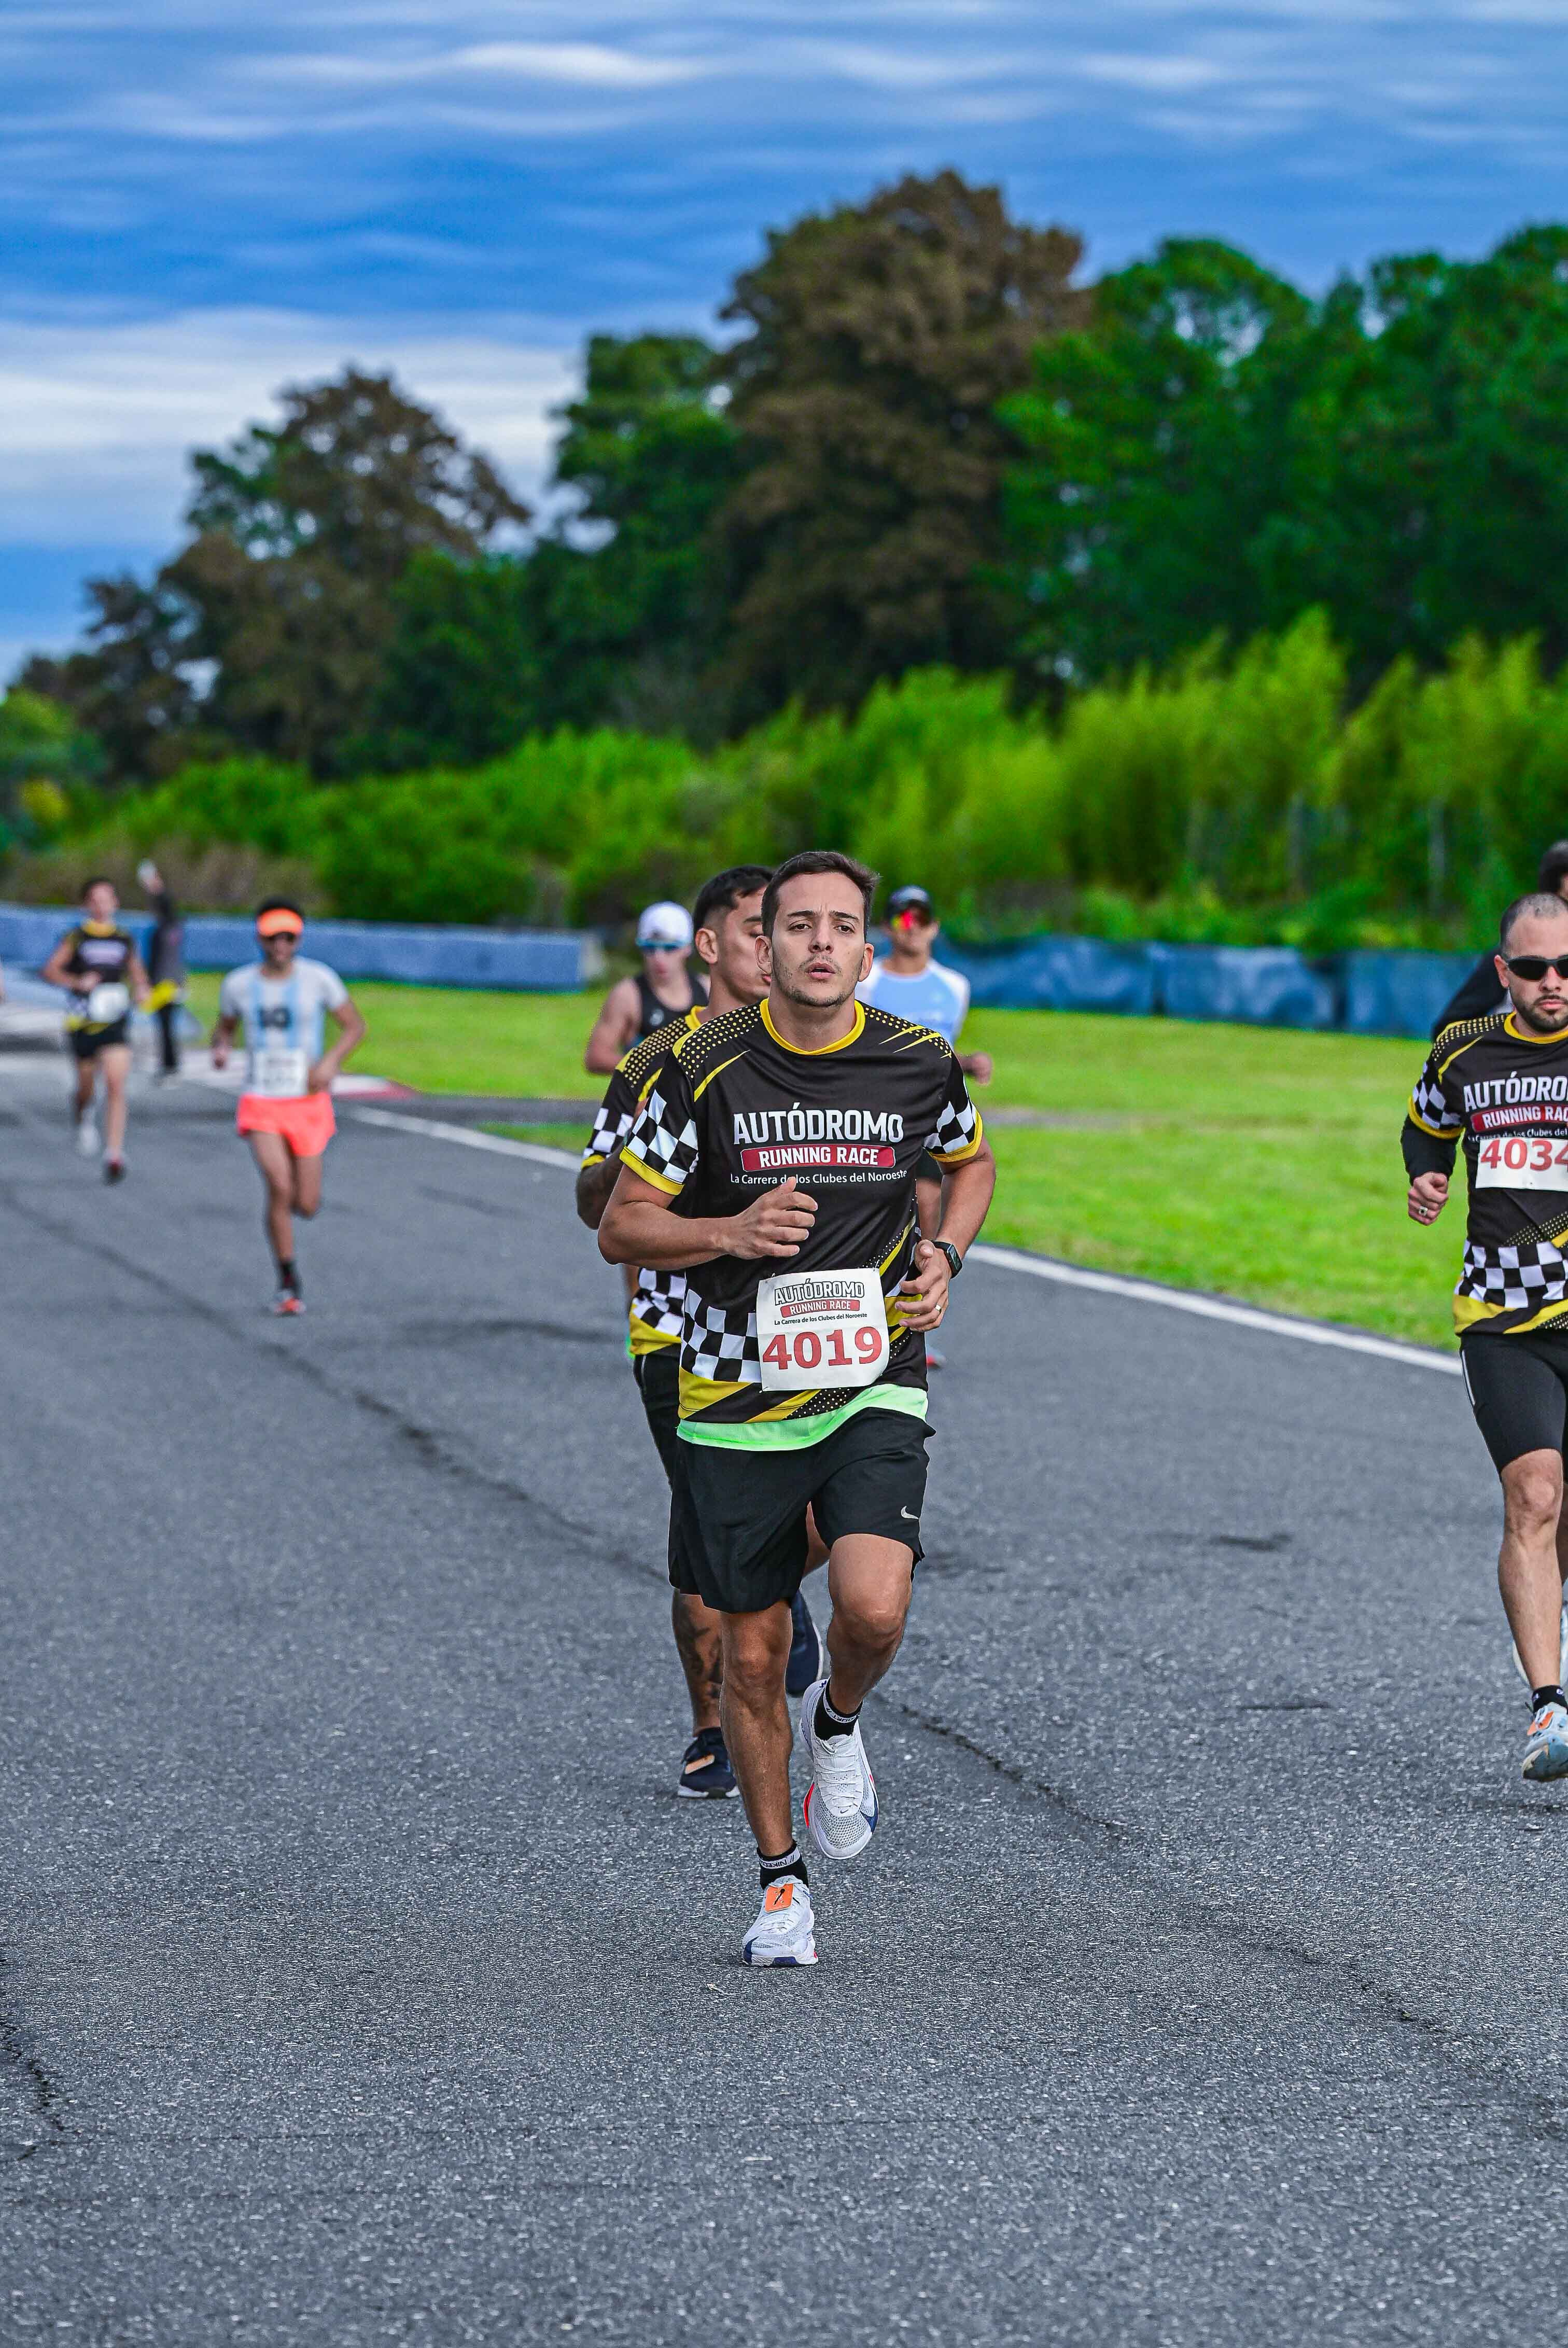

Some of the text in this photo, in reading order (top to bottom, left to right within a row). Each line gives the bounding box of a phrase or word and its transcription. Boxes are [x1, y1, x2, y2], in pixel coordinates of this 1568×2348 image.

[1463, 1071, 1568, 1112] AUTÓDRO
[733, 1102, 904, 1144] AUTÓDROMO
[1482, 1106, 1541, 1129] RUNNING
[1527, 1128, 1552, 1138] Clubes
[1555, 1128, 1567, 1136] del
[758, 1147, 879, 1168] RUNNING RACE
[1480, 1139, 1568, 1171] 4034
[731, 1169, 907, 1184] La Carrera d los Clubes del Noroeste
[774, 1278, 864, 1306] AUTÓDROMO
[789, 1300, 851, 1316] RUNNING RACE
[762, 1326, 882, 1369] 4019
